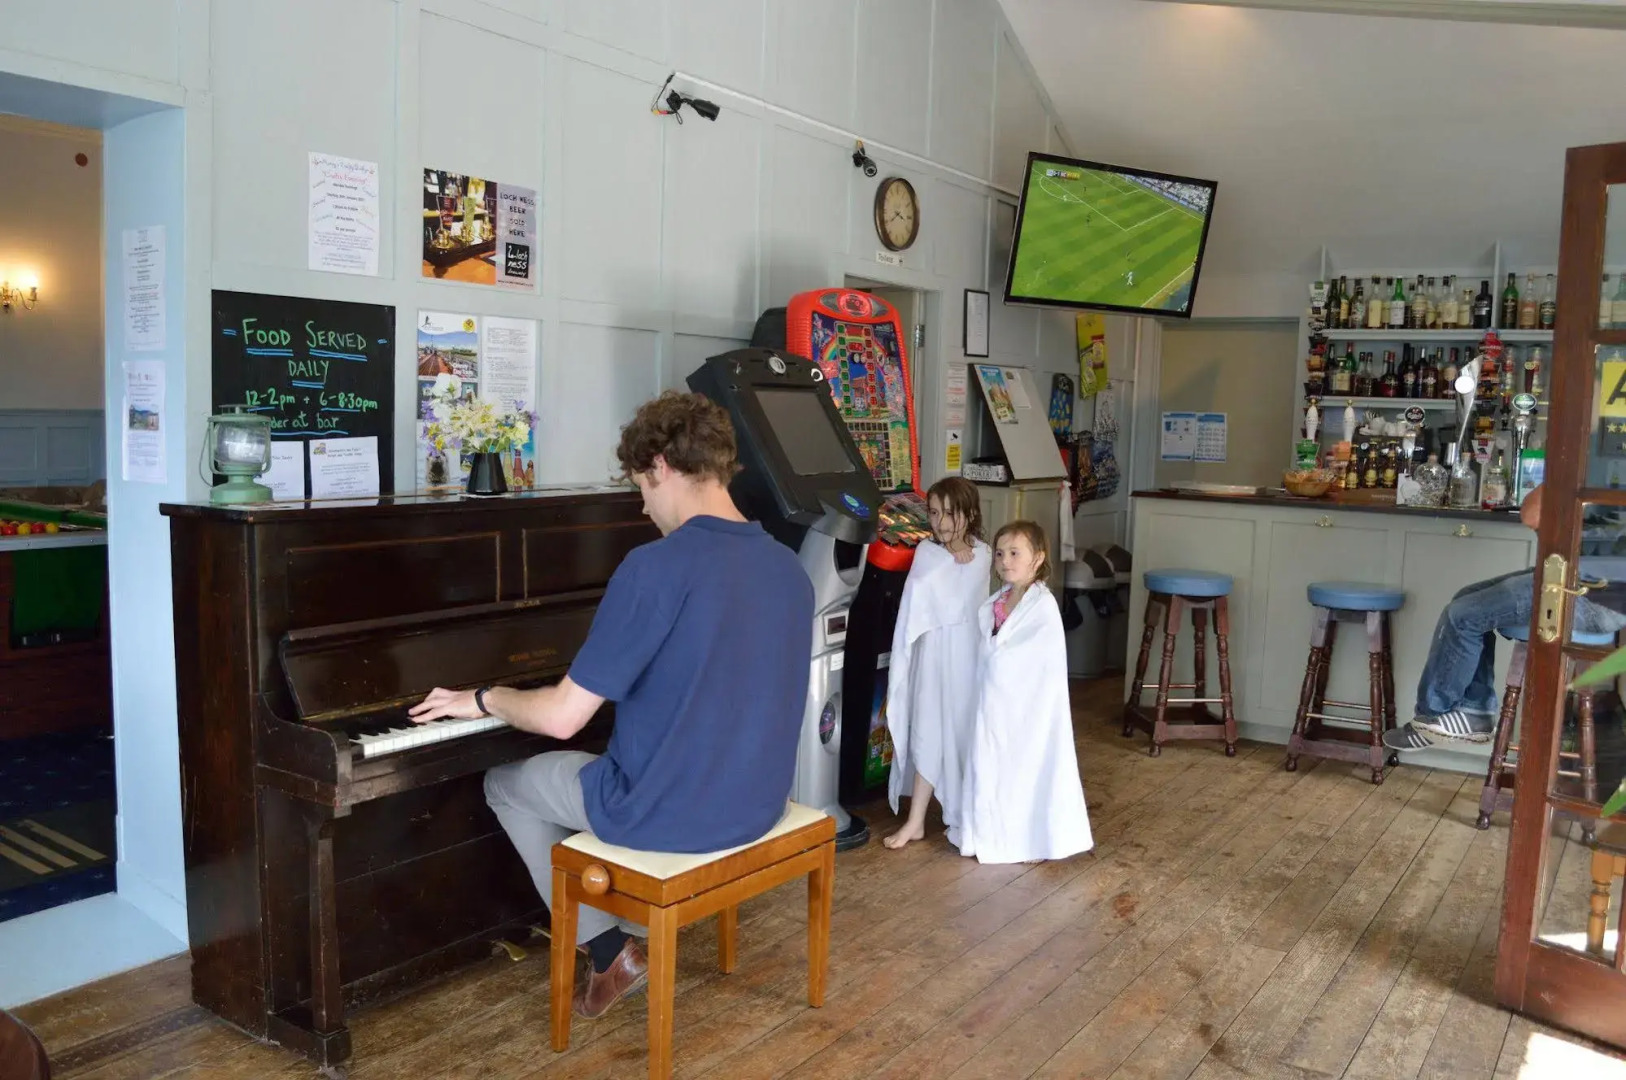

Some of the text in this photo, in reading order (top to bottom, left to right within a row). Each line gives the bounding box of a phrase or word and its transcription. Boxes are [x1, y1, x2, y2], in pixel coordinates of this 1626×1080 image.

[500, 193, 517, 201] LOCH
[509, 206, 526, 214] BEER
[510, 218, 525, 226] SOLD
[509, 229, 525, 237] HERE
[243, 318, 367, 350] FOOD SERVED
[288, 360, 329, 384] DAILY
[292, 411, 309, 427] at
[316, 412, 339, 428] bar
